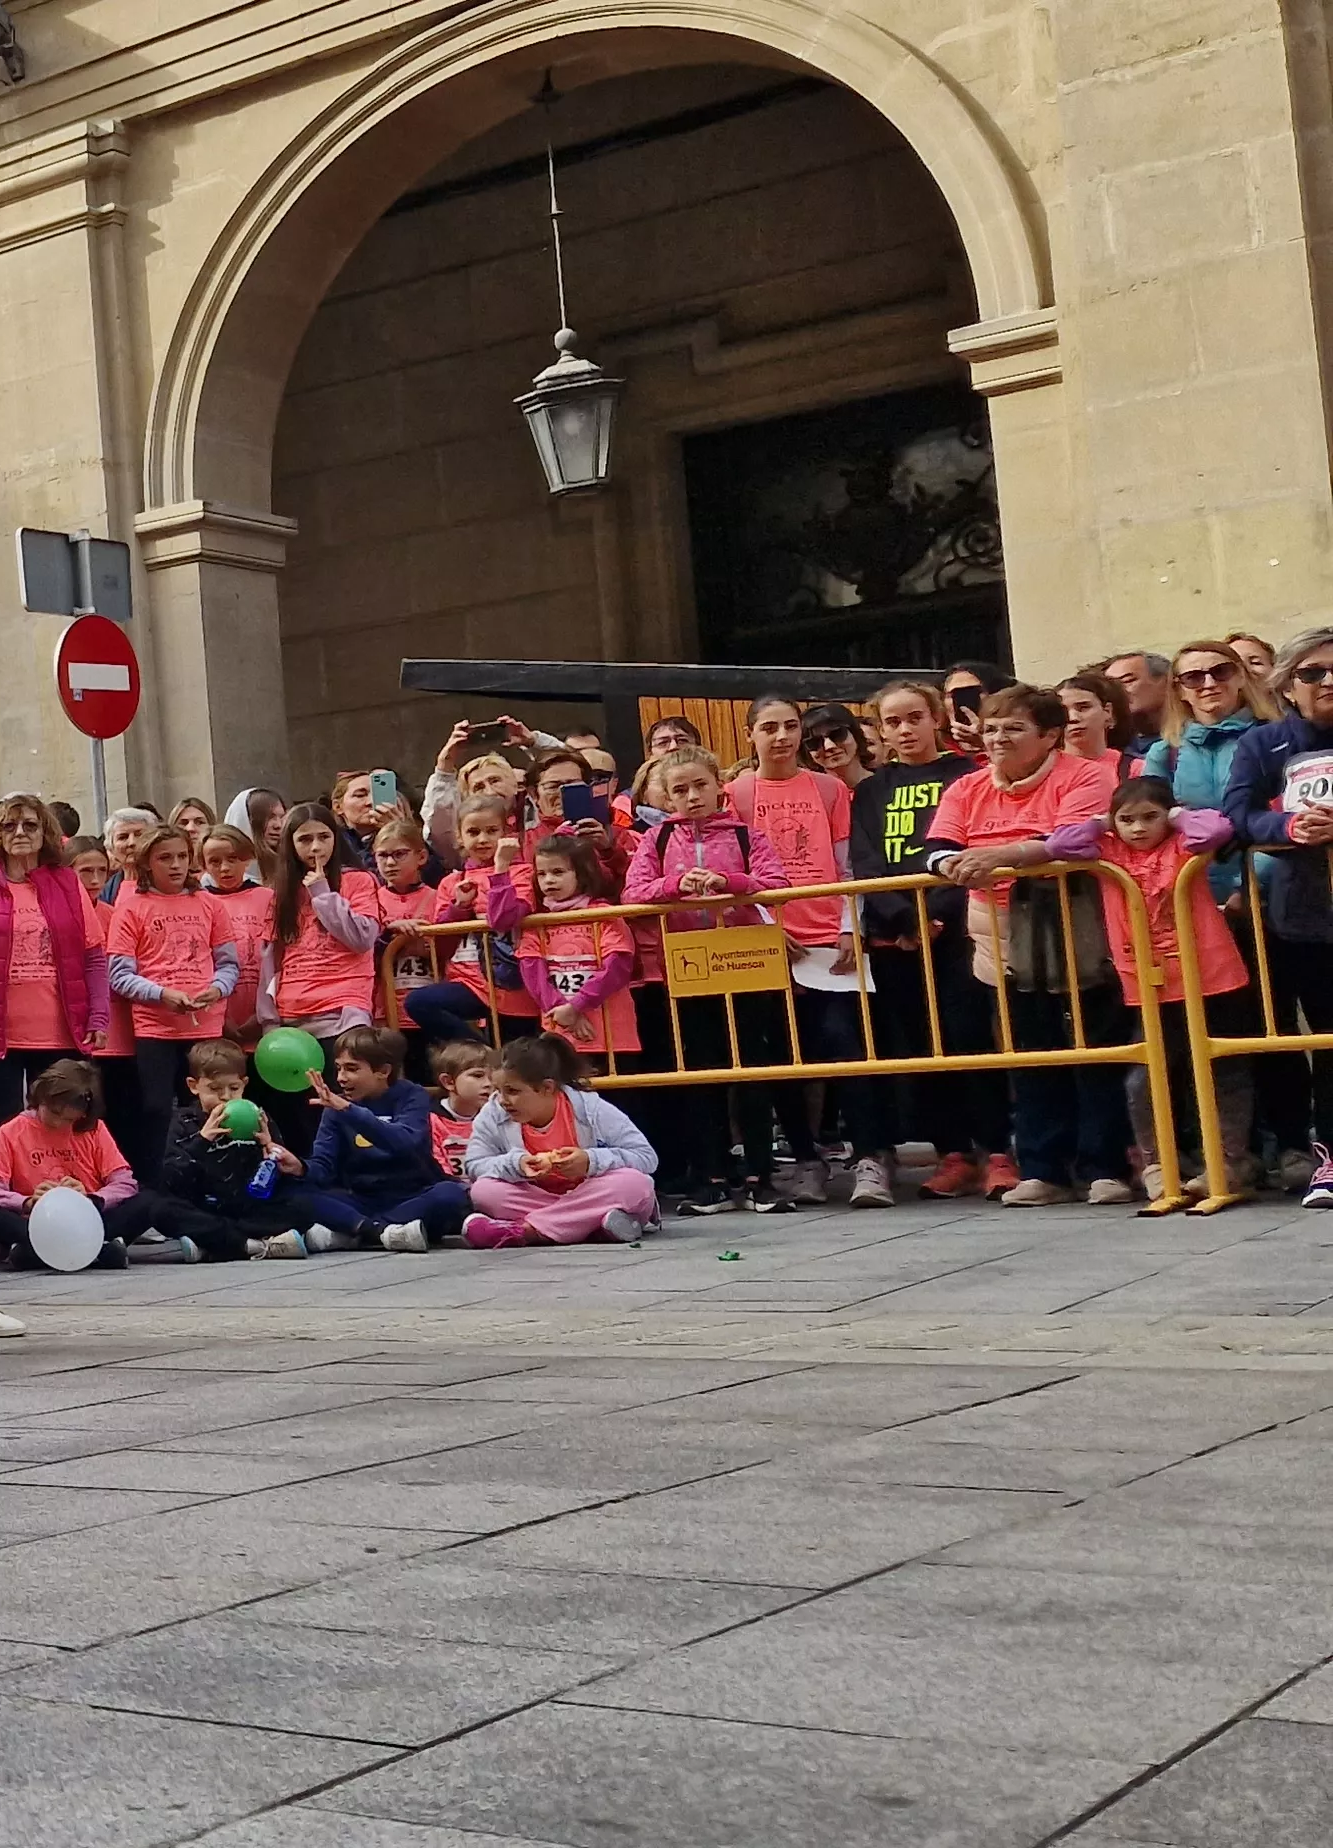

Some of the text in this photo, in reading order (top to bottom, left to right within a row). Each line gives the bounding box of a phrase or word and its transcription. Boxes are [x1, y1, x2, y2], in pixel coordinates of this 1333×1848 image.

[886, 781, 944, 811] JUST
[885, 810, 916, 838] DO
[884, 836, 906, 864] IT
[710, 947, 780, 963] Ayuntamiento
[711, 960, 766, 972] de Huesca
